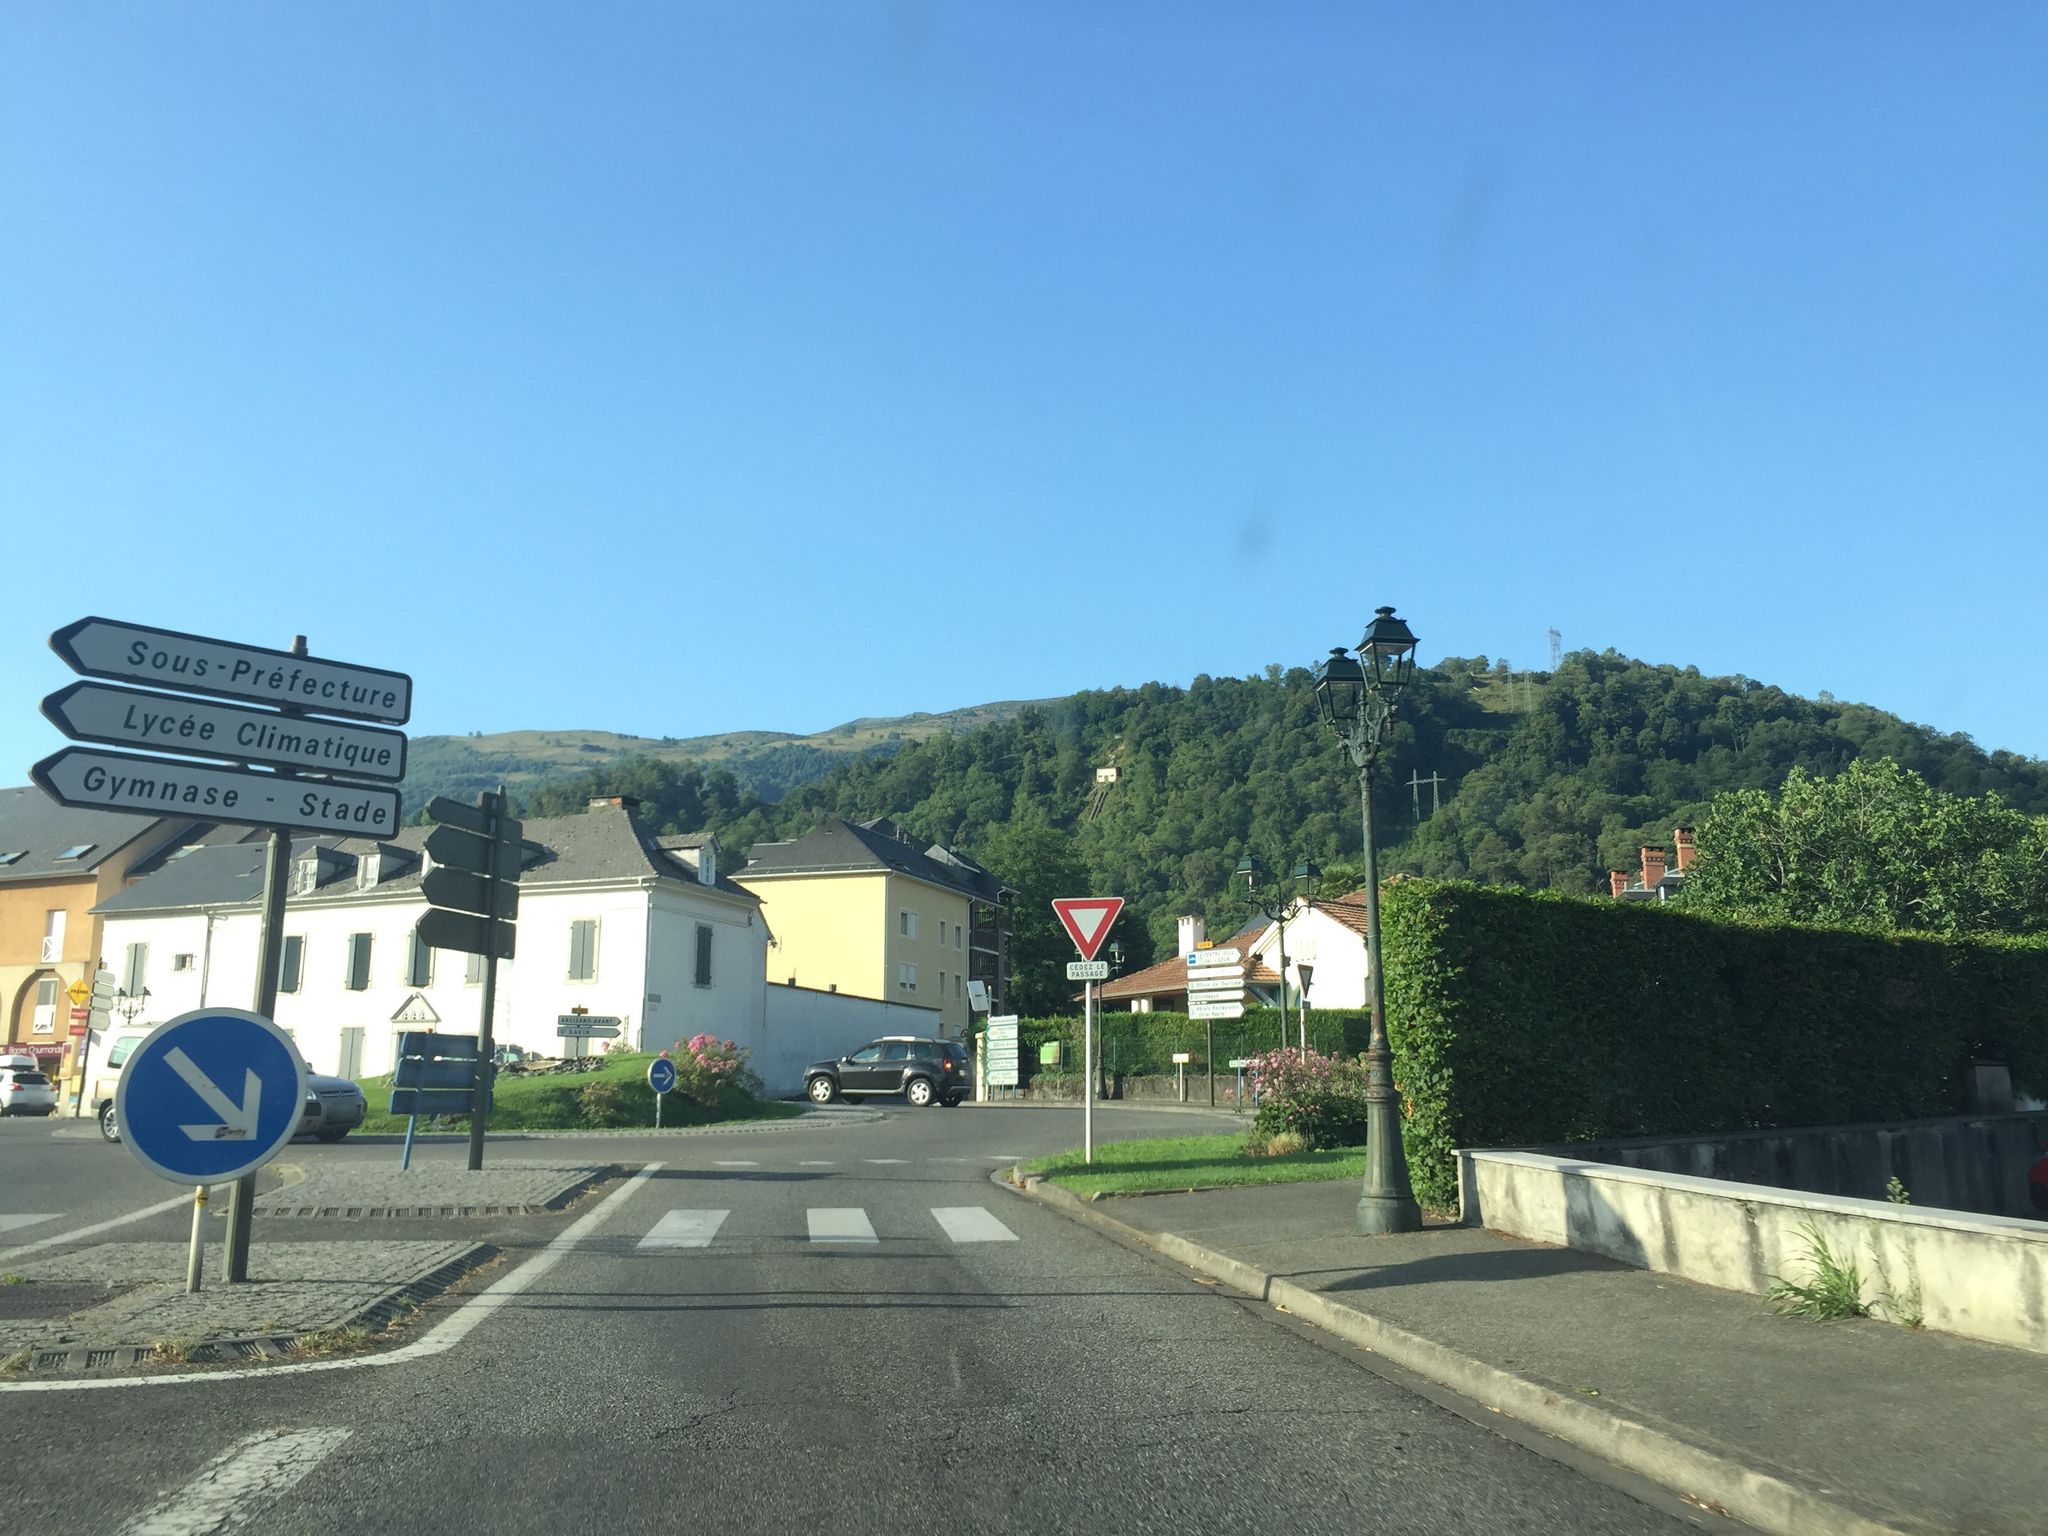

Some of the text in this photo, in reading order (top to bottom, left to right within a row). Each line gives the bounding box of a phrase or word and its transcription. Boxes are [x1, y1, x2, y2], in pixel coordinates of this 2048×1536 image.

[127, 640, 397, 709] Sous-Préfecture
[123, 704, 392, 767] Lycée Climatique
[83, 766, 239, 808] Gymnase
[299, 793, 387, 825] Stade
[1071, 970, 1104, 978] PASSAGE
